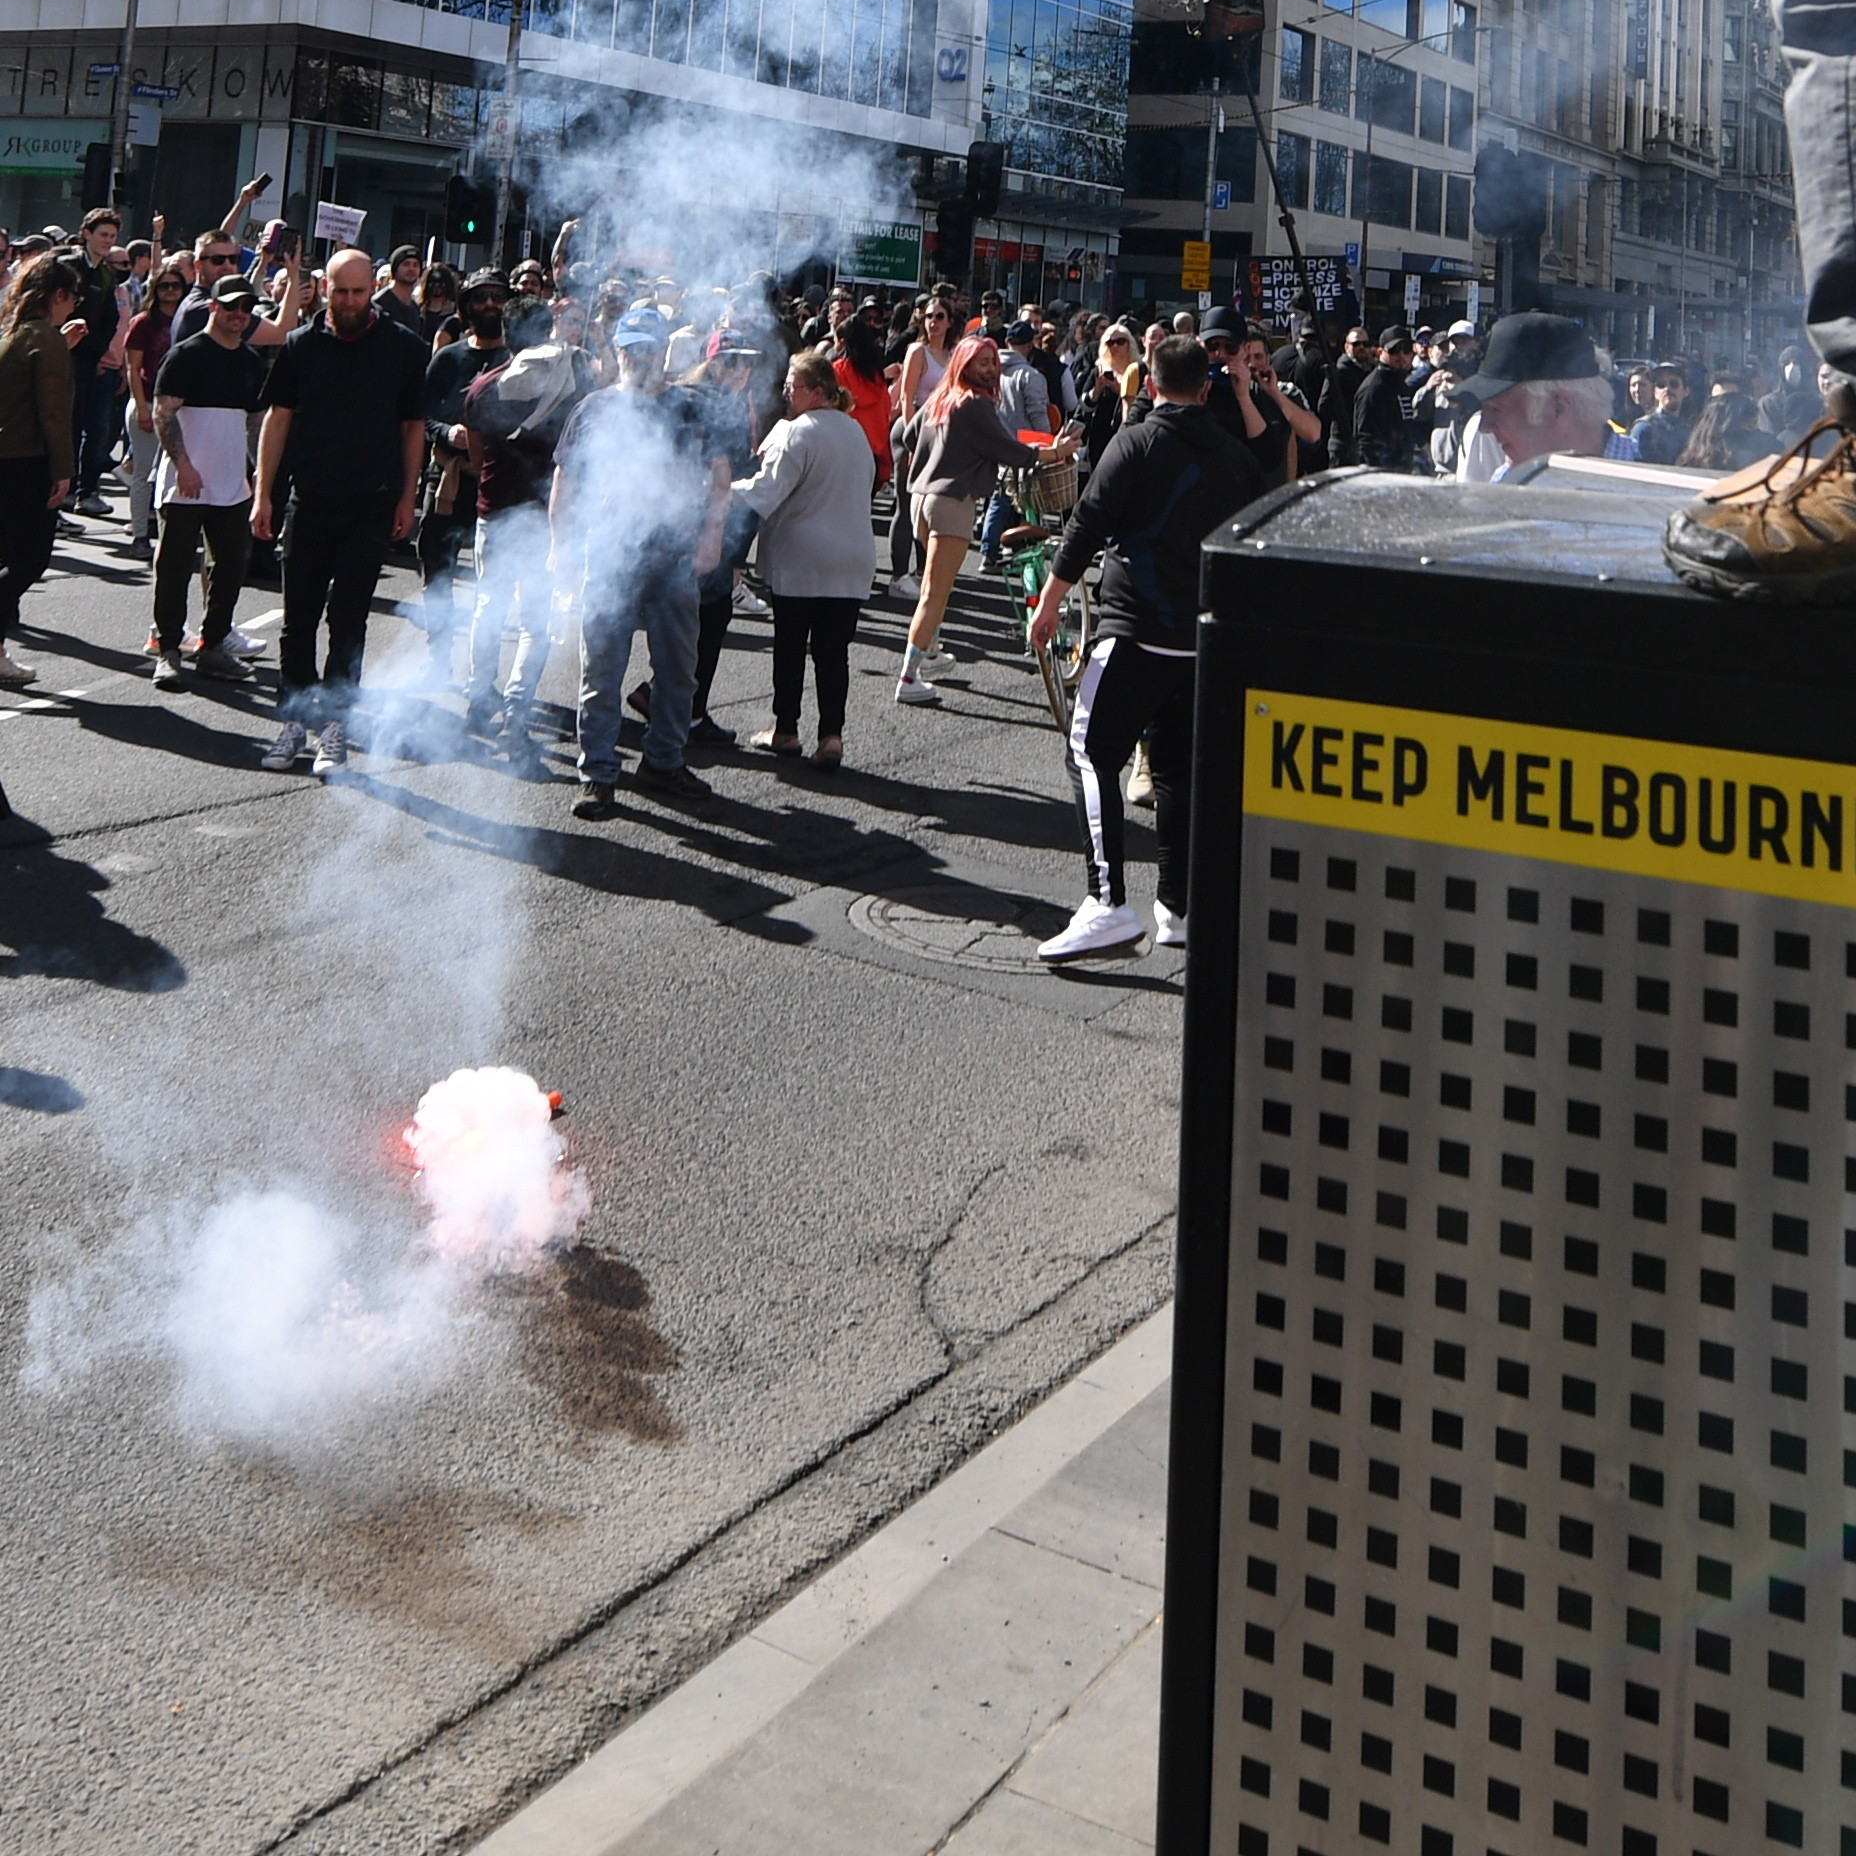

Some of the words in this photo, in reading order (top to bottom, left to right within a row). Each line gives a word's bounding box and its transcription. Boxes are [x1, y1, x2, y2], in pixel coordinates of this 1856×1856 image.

[937, 48, 967, 82] Q2
[1216, 183, 1227, 197] P
[874, 223, 892, 238] FOR
[894, 226, 919, 242] LEASE
[1269, 719, 1429, 808] KEEP
